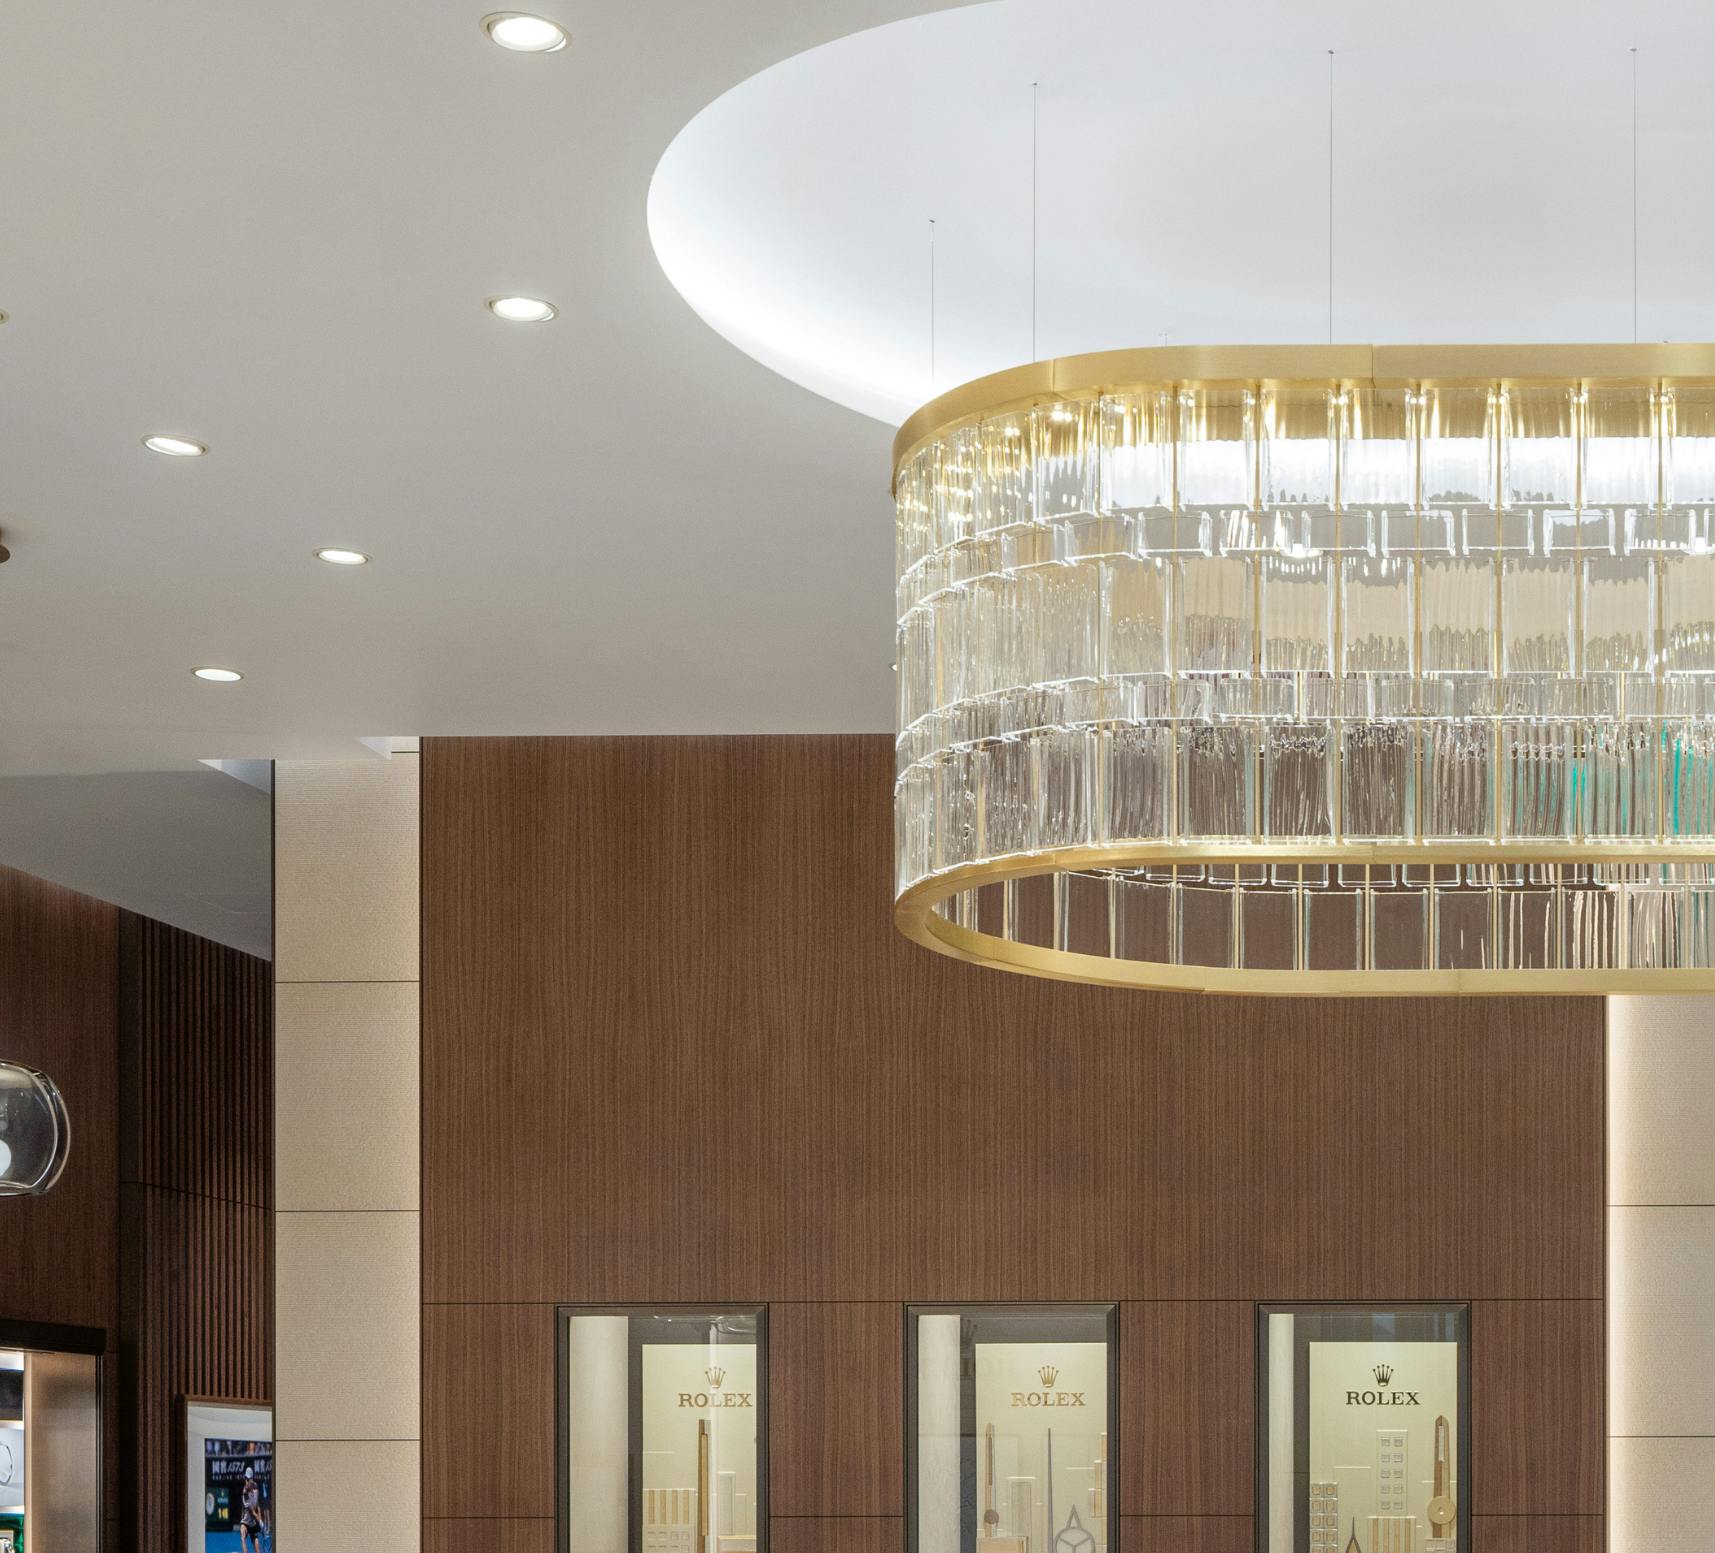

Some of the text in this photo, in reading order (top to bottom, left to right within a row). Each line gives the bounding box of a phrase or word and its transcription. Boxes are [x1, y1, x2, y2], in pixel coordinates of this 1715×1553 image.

[677, 1392, 753, 1408] ROLEX
[1010, 1391, 1087, 1407] ROLEX
[1345, 1390, 1421, 1406] ROLEX
